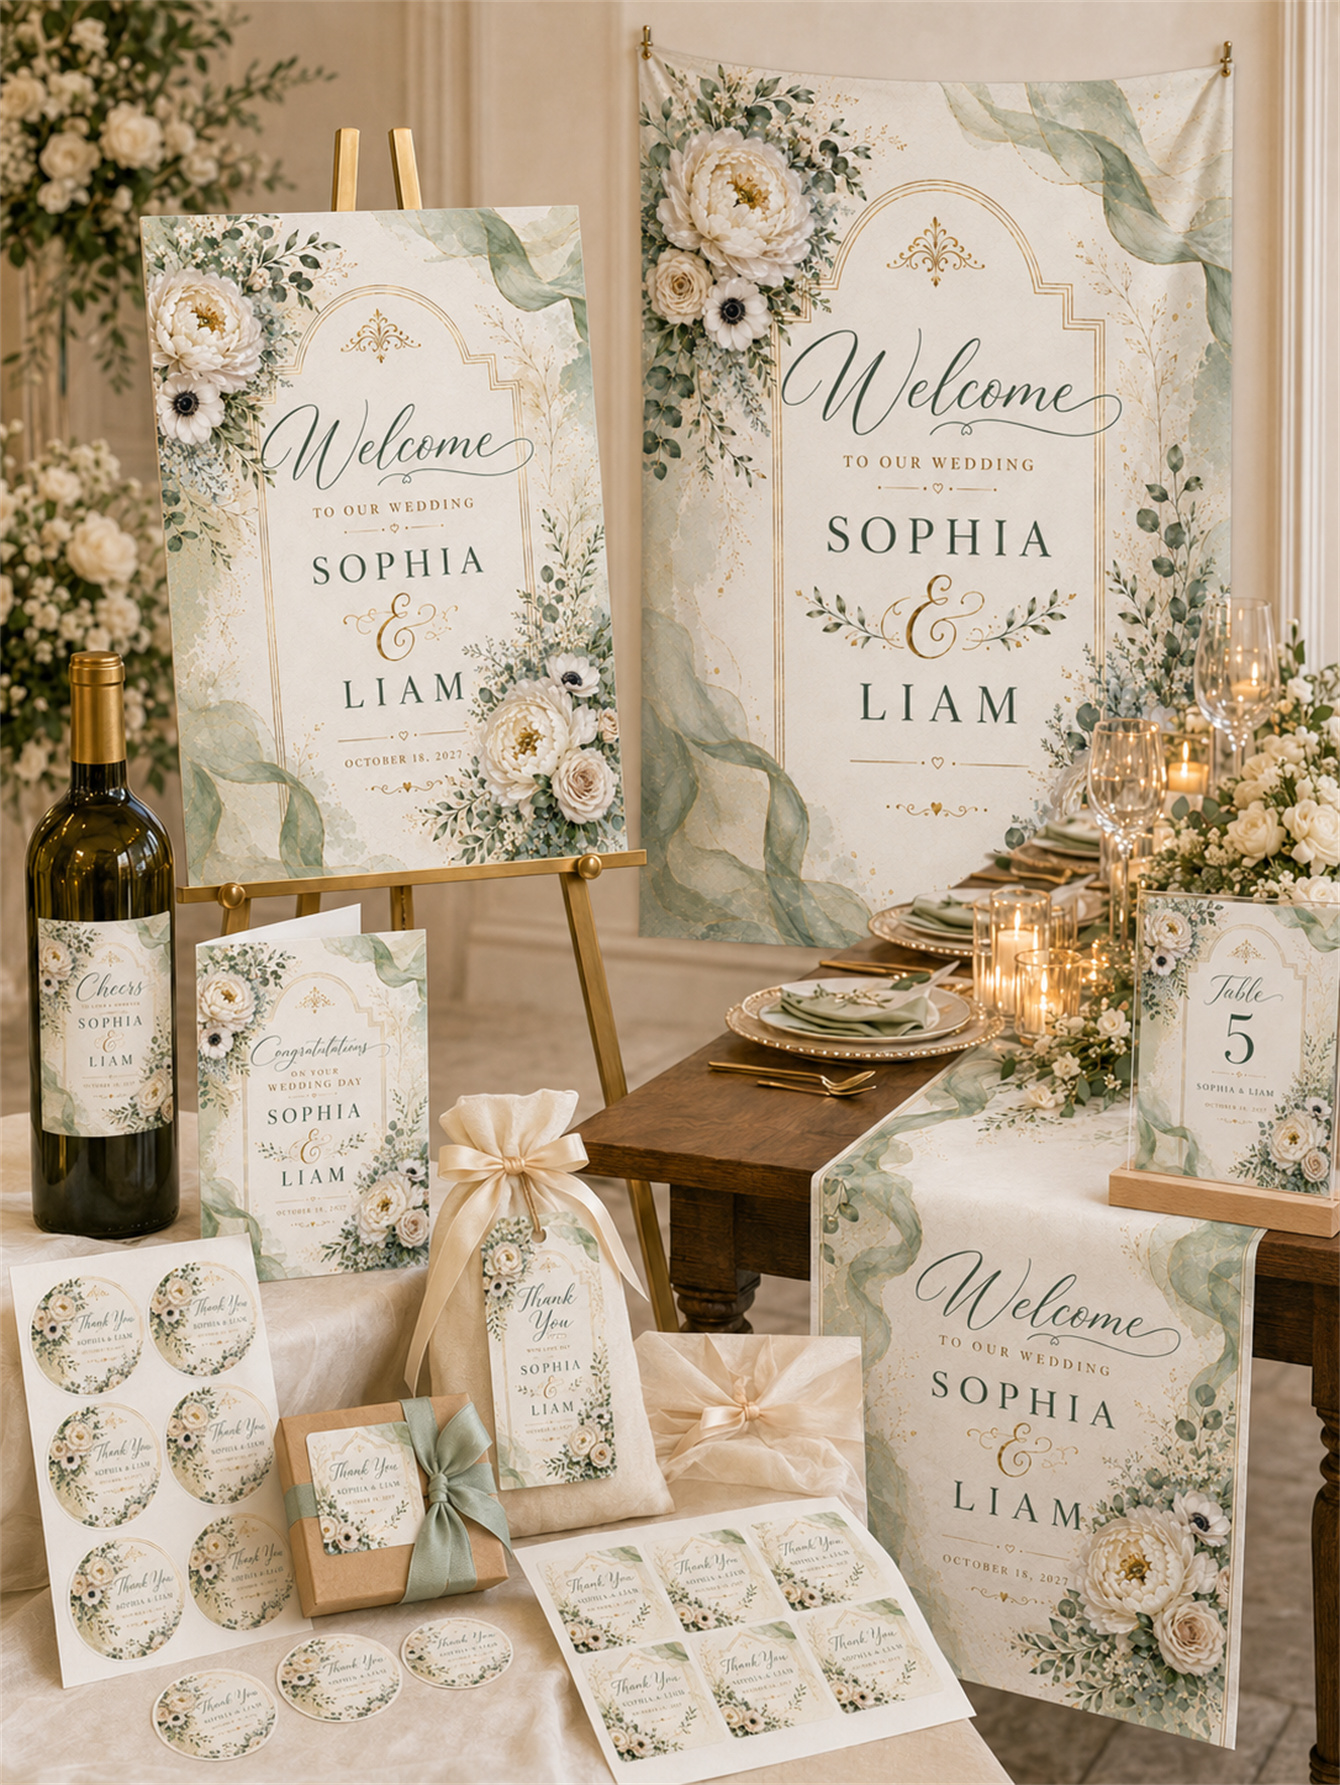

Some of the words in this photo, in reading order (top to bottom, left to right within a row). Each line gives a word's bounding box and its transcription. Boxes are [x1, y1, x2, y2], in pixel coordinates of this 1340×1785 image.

[781, 328, 1123, 437] Welcome
[261, 399, 534, 490] Welcome
[843, 455, 869, 469] TO
[879, 455, 922, 470] OUR
[932, 456, 1035, 472] WEDDING
[312, 506, 334, 519] TO
[343, 503, 380, 517] OUR
[389, 497, 475, 513] WEDDING
[826, 515, 1052, 558] SOPHIA
[312, 546, 484, 585] SOPHIA
[362, 592, 437, 661] &
[896, 574, 985, 660] &
[343, 672, 465, 709] LIAM
[859, 682, 1018, 724] LIAM
[344, 754, 407, 769] OCTOBER
[435, 749, 462, 761] 2027
[76, 972, 150, 1002] Cheers
[1203, 974, 1284, 1006] Table
[78, 1015, 143, 1029] SOPHIA
[99, 1030, 120, 1053] &
[1224, 1013, 1254, 1065] 5
[89, 1054, 133, 1068] LIAM
[290, 1070, 307, 1078] ON
[310, 1068, 339, 1076] YOUR
[268, 1081, 332, 1092] WEDDING
[338, 1077, 362, 1087] DAY
[1196, 1083, 1235, 1094] SOPHIA
[1248, 1088, 1275, 1097] LIAM
[267, 1103, 361, 1125] SOPHIA
[296, 1128, 329, 1165] &
[281, 1166, 345, 1187] LIAM
[516, 1283, 577, 1312] Thank
[915, 1250, 1181, 1357] Welcome
[76, 1312, 111, 1333] Thank
[529, 1309, 574, 1342] You
[520, 1360, 581, 1375] SOPHIA
[938, 1334, 962, 1348] TO
[972, 1340, 1009, 1357] OUR
[1020, 1350, 1111, 1377] WEDDING
[541, 1375, 560, 1399] &
[931, 1370, 1116, 1430] SOPHIA
[531, 1401, 574, 1416] LIAM
[94, 1440, 127, 1462] Thank
[985, 1423, 1053, 1478] &
[329, 1458, 369, 1482] Thank
[954, 1480, 1082, 1531] LIAM
[942, 1553, 1008, 1576] OCTOBER
[1039, 1573, 1069, 1586] 2027
